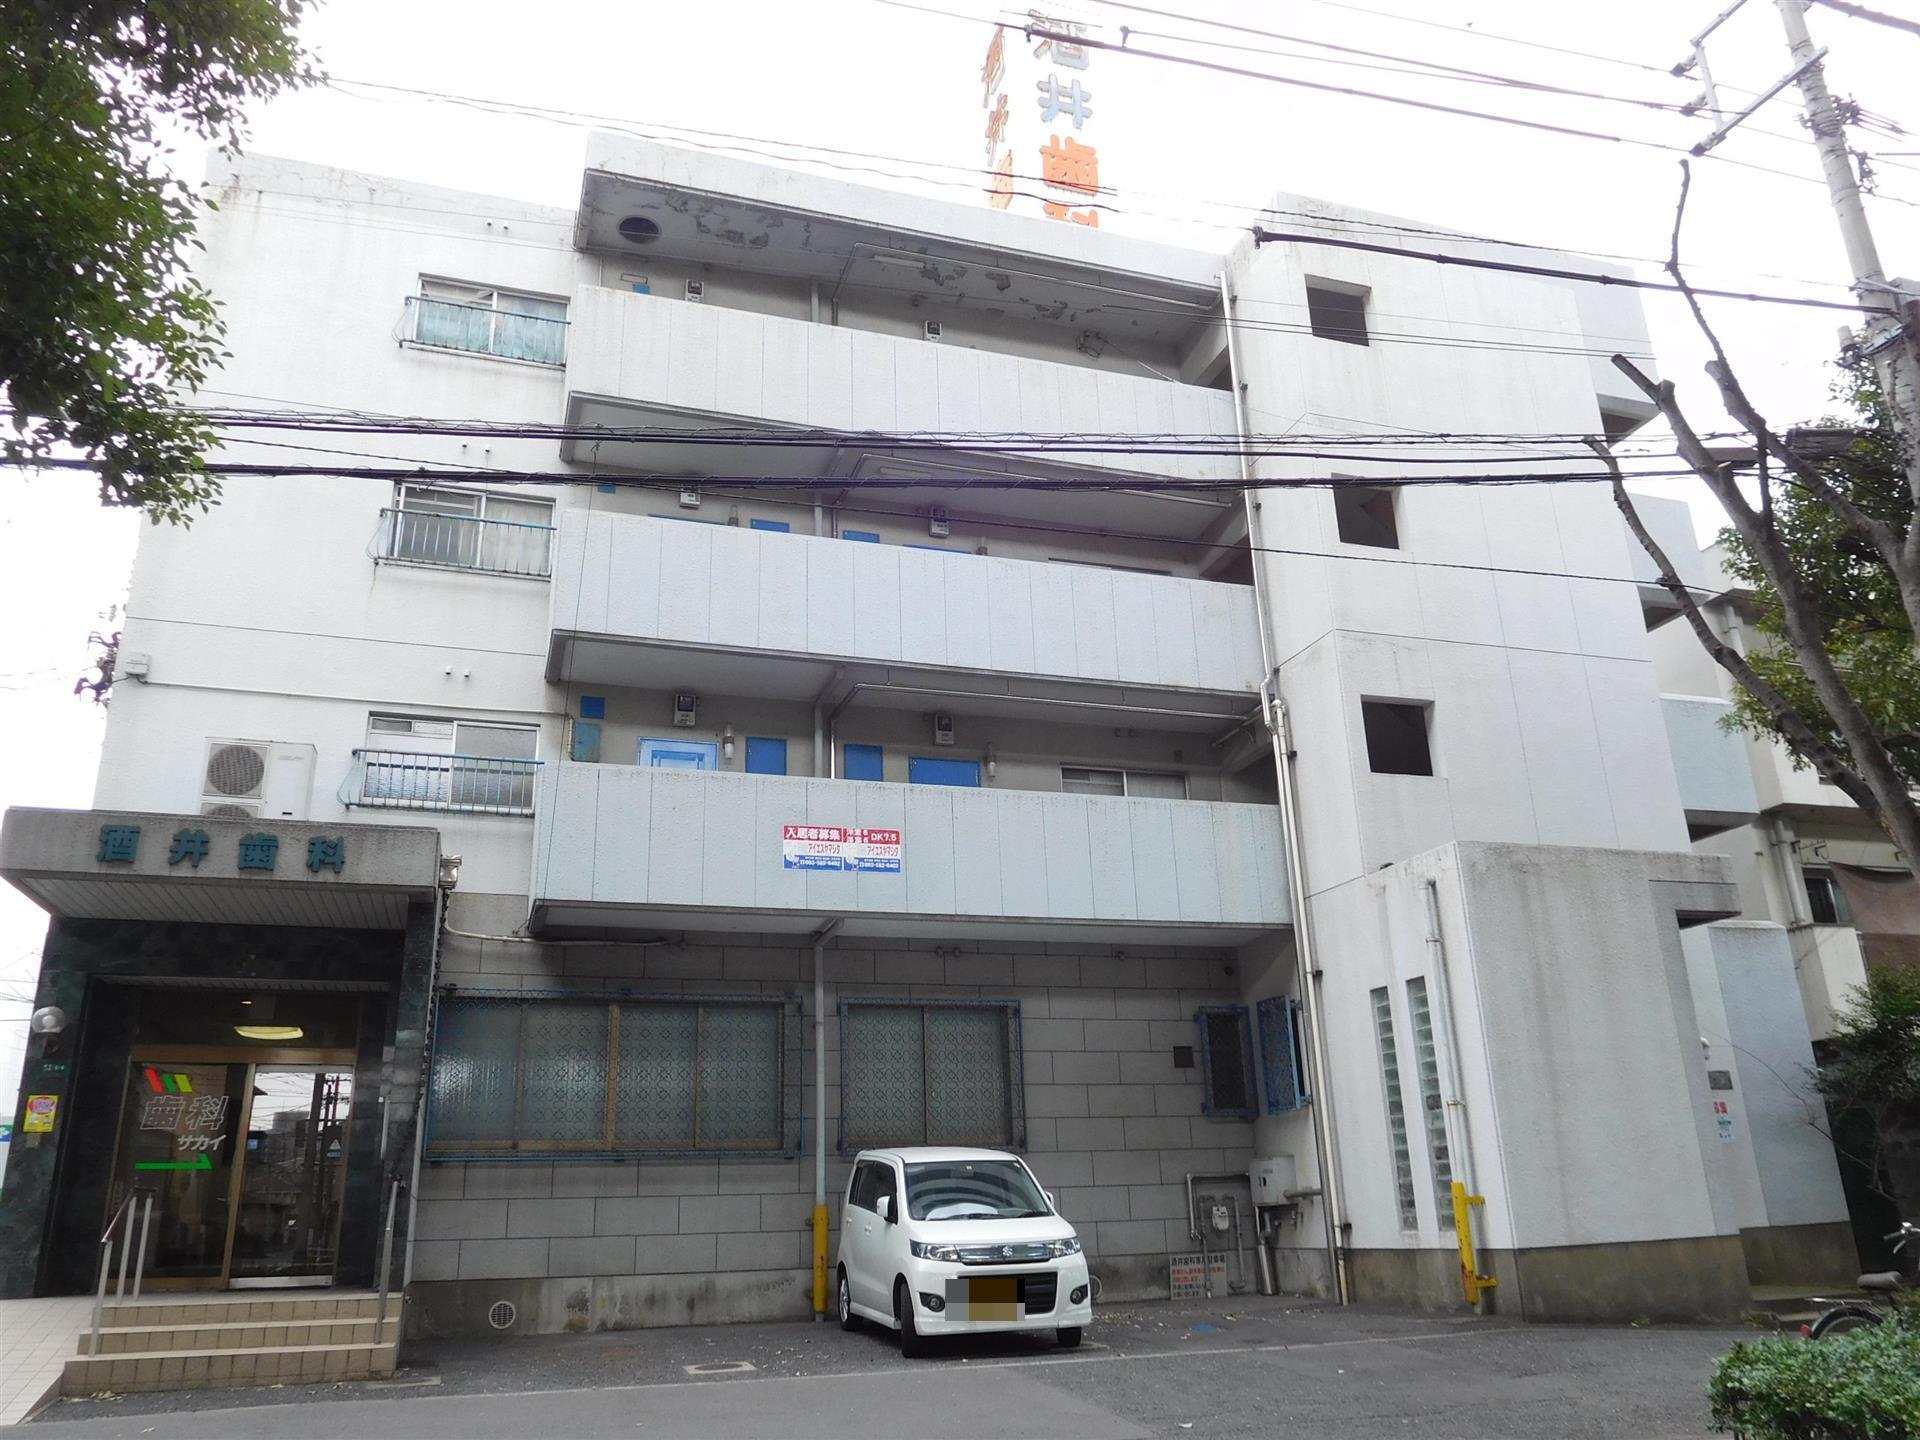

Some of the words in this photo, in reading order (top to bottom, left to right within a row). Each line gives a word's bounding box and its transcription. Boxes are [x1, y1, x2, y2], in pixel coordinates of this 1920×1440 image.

[786, 827, 840, 840] 入居者募集
[870, 833, 897, 841] DK7.5
[96, 824, 346, 874] 酒井歯科
[140, 1095, 229, 1130] 歯科
[177, 1134, 227, 1151] サカイ
